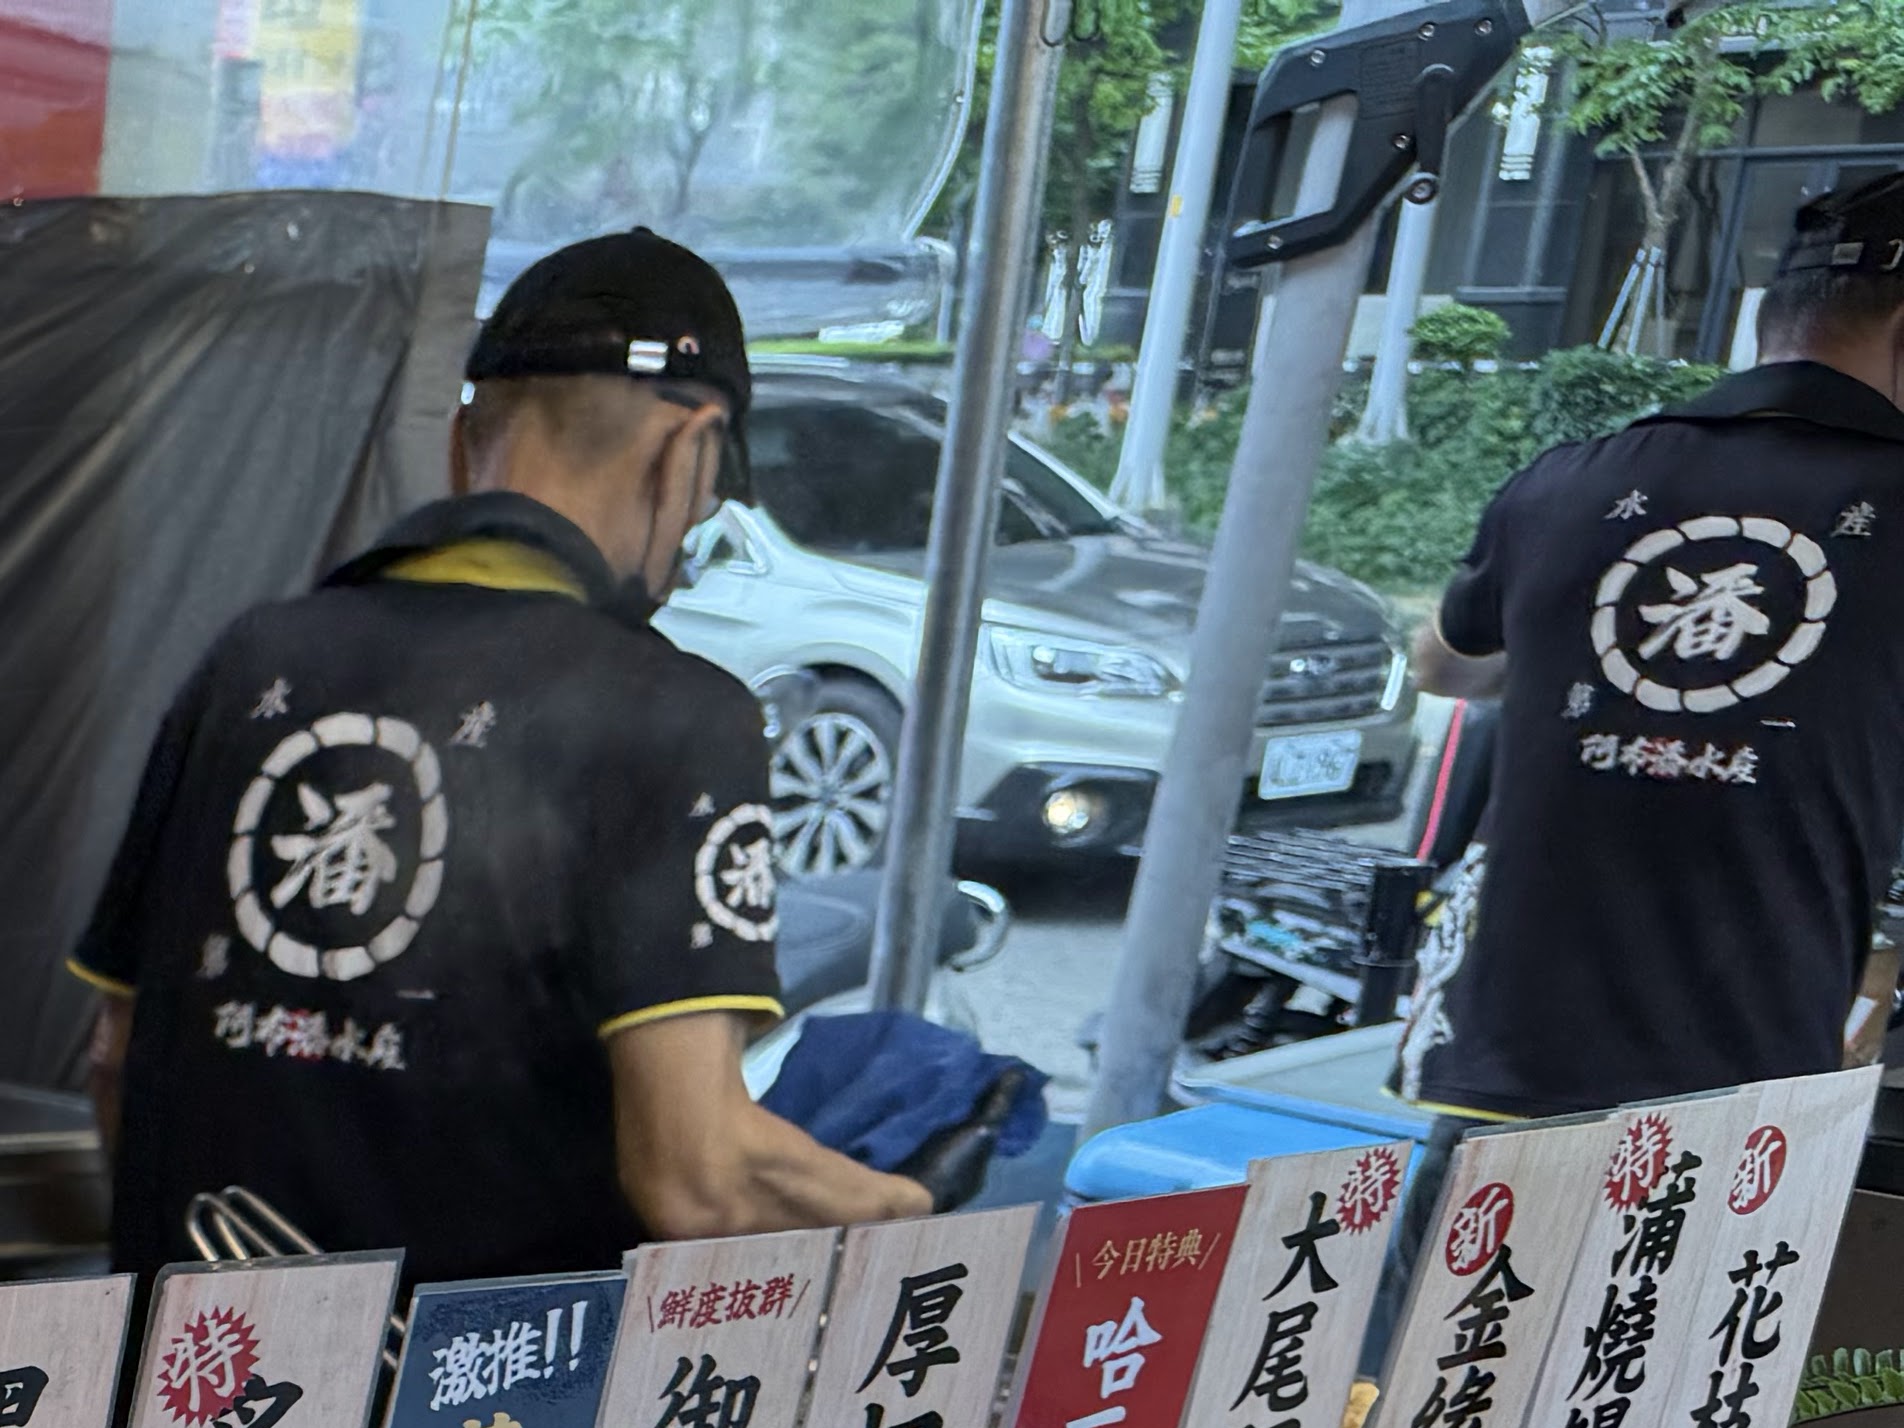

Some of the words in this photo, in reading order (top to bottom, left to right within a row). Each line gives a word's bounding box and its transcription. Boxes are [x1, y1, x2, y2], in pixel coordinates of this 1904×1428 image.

[1638, 562, 1770, 661] 潘
[271, 781, 397, 915] 潘
[1092, 1226, 1206, 1281] 今日特典
